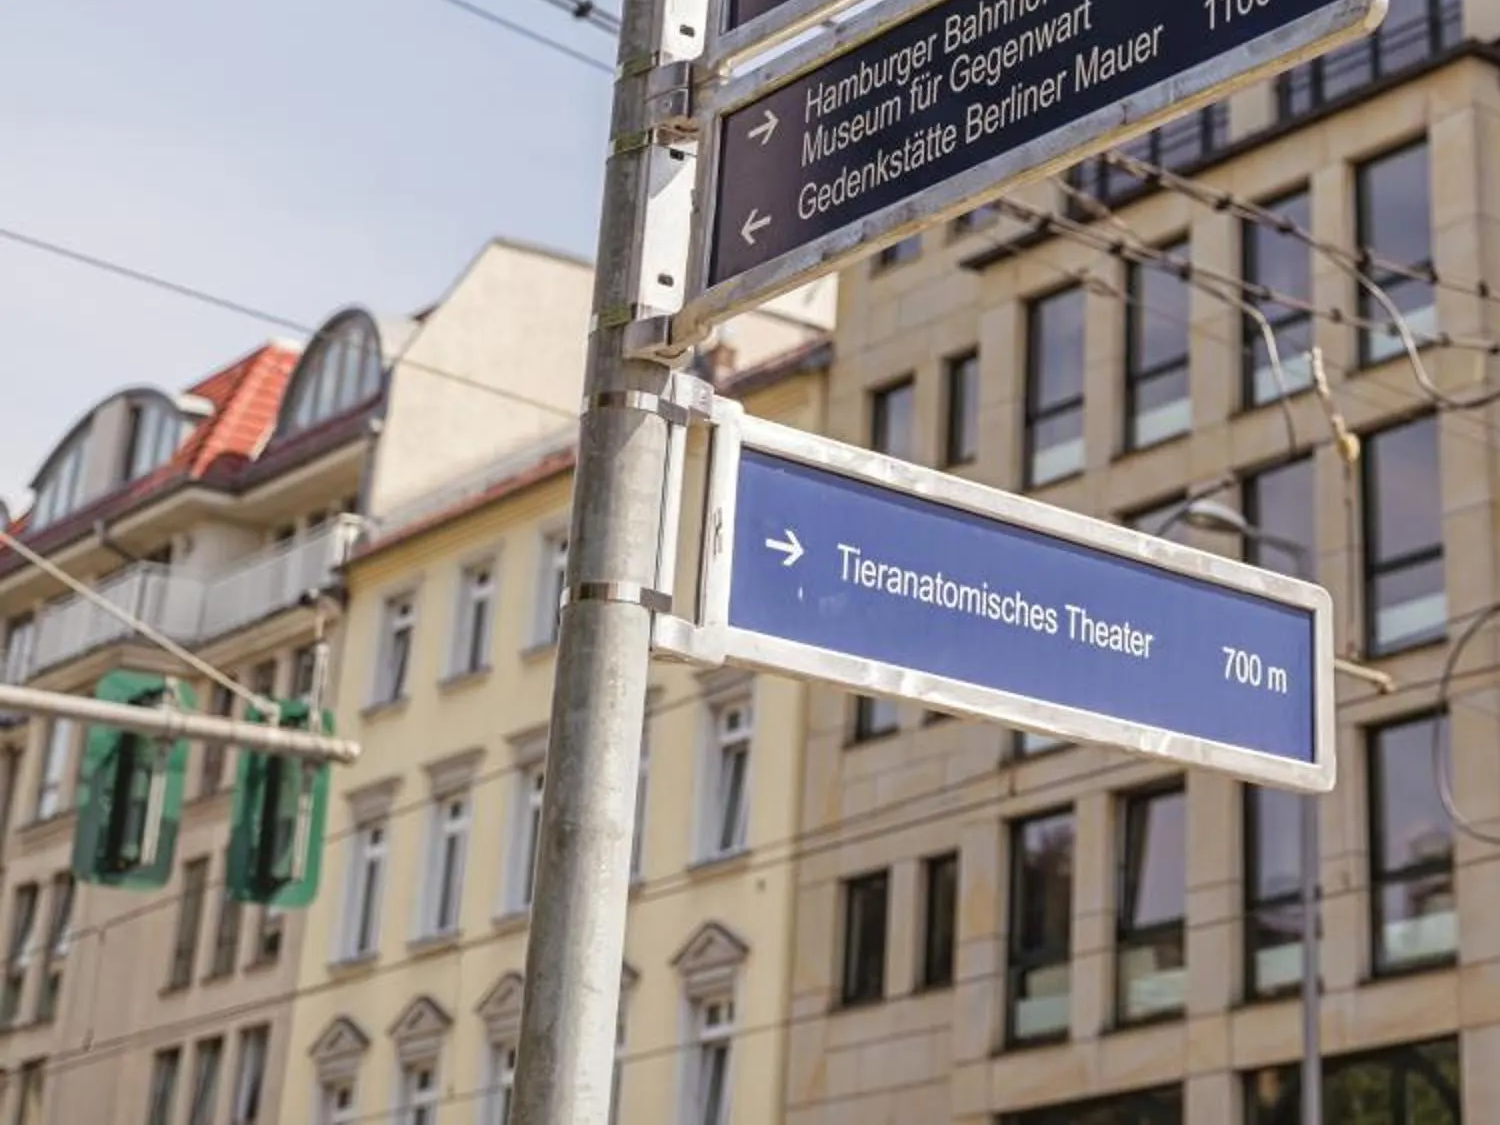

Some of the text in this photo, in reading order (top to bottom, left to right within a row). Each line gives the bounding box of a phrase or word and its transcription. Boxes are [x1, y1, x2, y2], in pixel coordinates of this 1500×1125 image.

[798, 122, 958, 220] Gedenkstätte
[965, 70, 1067, 144] Berliner
[1073, 23, 1164, 93] Mauer
[802, 92, 903, 168] Museum
[909, 74, 943, 114] für
[804, 33, 938, 124] Hamburger
[837, 542, 1289, 694] Tieranatomisches Theater 700 m
